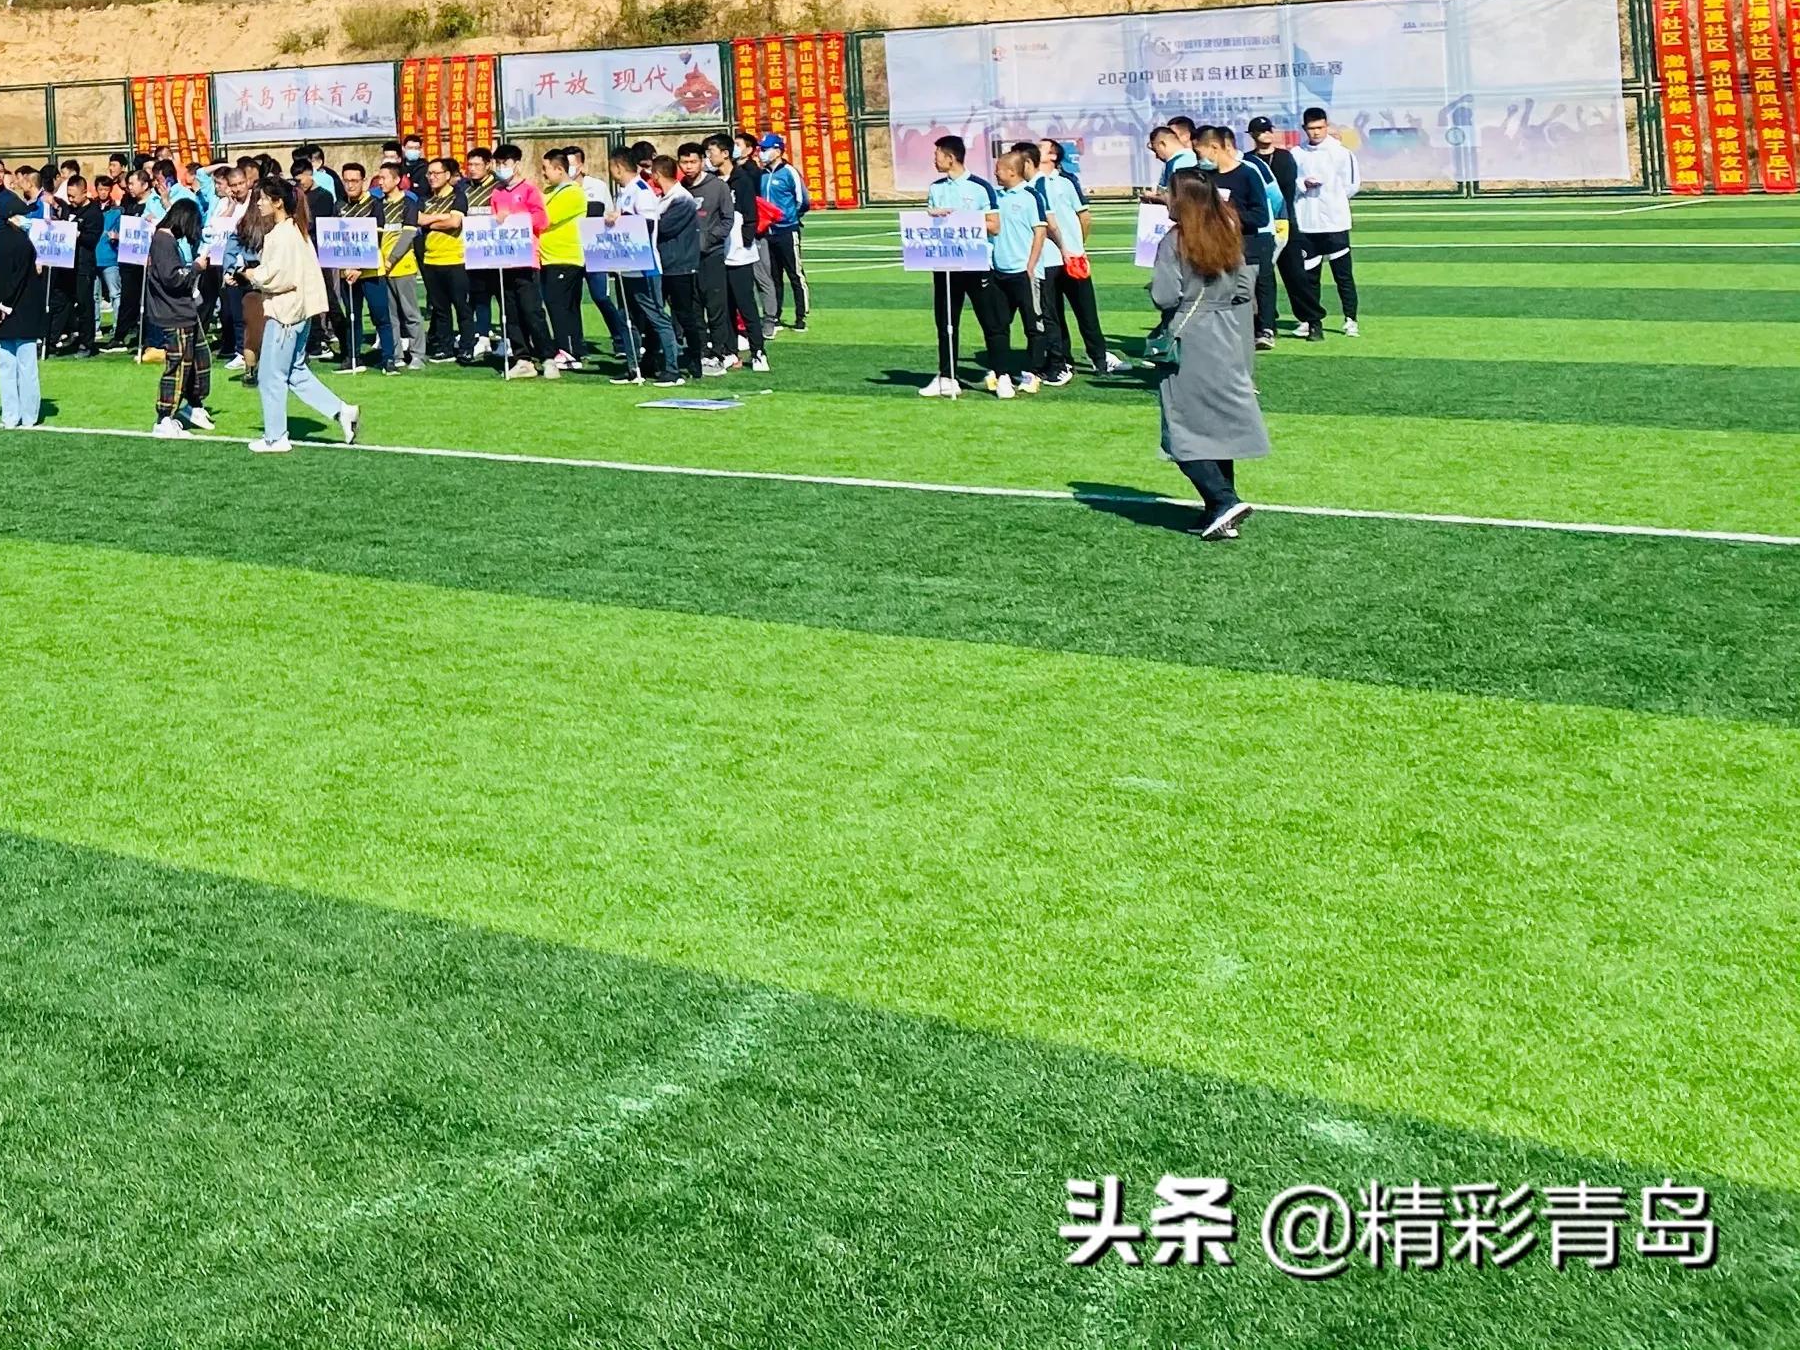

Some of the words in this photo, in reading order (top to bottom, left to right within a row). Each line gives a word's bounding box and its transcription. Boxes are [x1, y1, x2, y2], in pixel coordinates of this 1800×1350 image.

[536, 69, 594, 99] 开放
[612, 64, 674, 93] 现代
[767, 41, 783, 90] 南王社区
[236, 82, 373, 111] 青岛市体育局
[1663, 54, 1699, 185] 激情燃烧、飞扬梦想
[1754, 66, 1791, 182] 无限风采、始于足下
[483, 244, 516, 257] 足球队
[925, 245, 965, 258] 足球队
